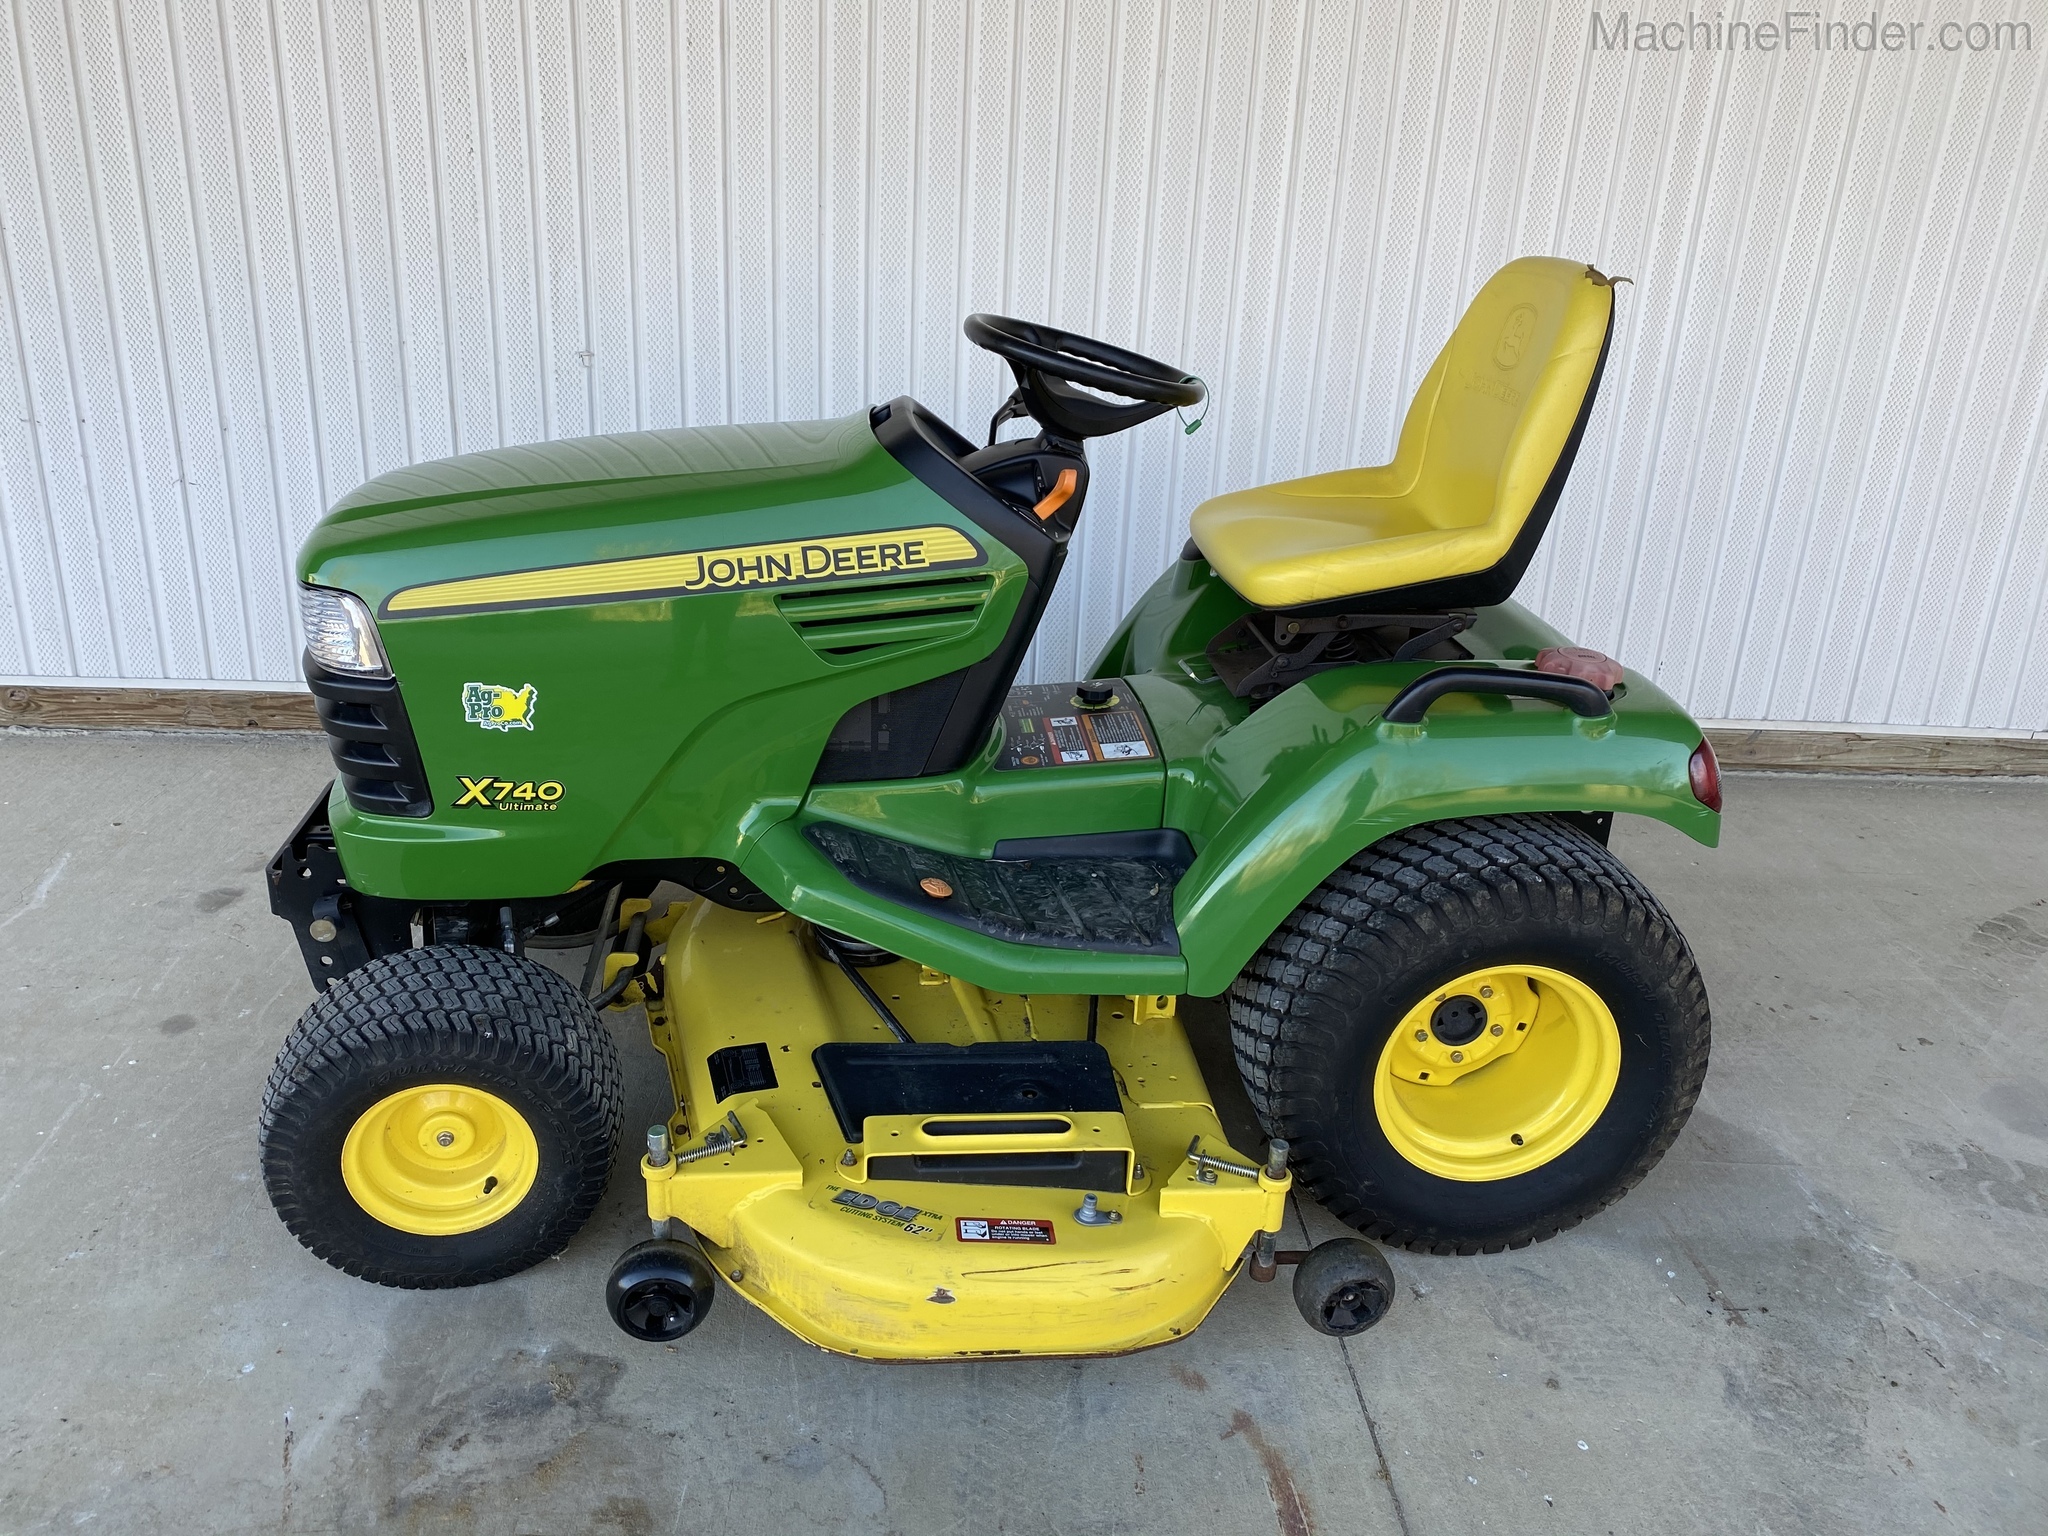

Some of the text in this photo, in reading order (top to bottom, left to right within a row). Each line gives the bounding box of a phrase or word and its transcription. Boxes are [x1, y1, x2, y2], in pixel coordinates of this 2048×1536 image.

[685, 540, 927, 590] JOHN DEERE
[466, 685, 501, 706] Ag-
[468, 702, 503, 720] Pro
[452, 776, 566, 808] X740
[498, 802, 558, 811] Ultimate
[825, 1184, 842, 1192] THE
[830, 1188, 921, 1223] EDGE
[839, 1206, 905, 1228] CUTTING SYSTEM
[904, 1223, 934, 1235] 62"
